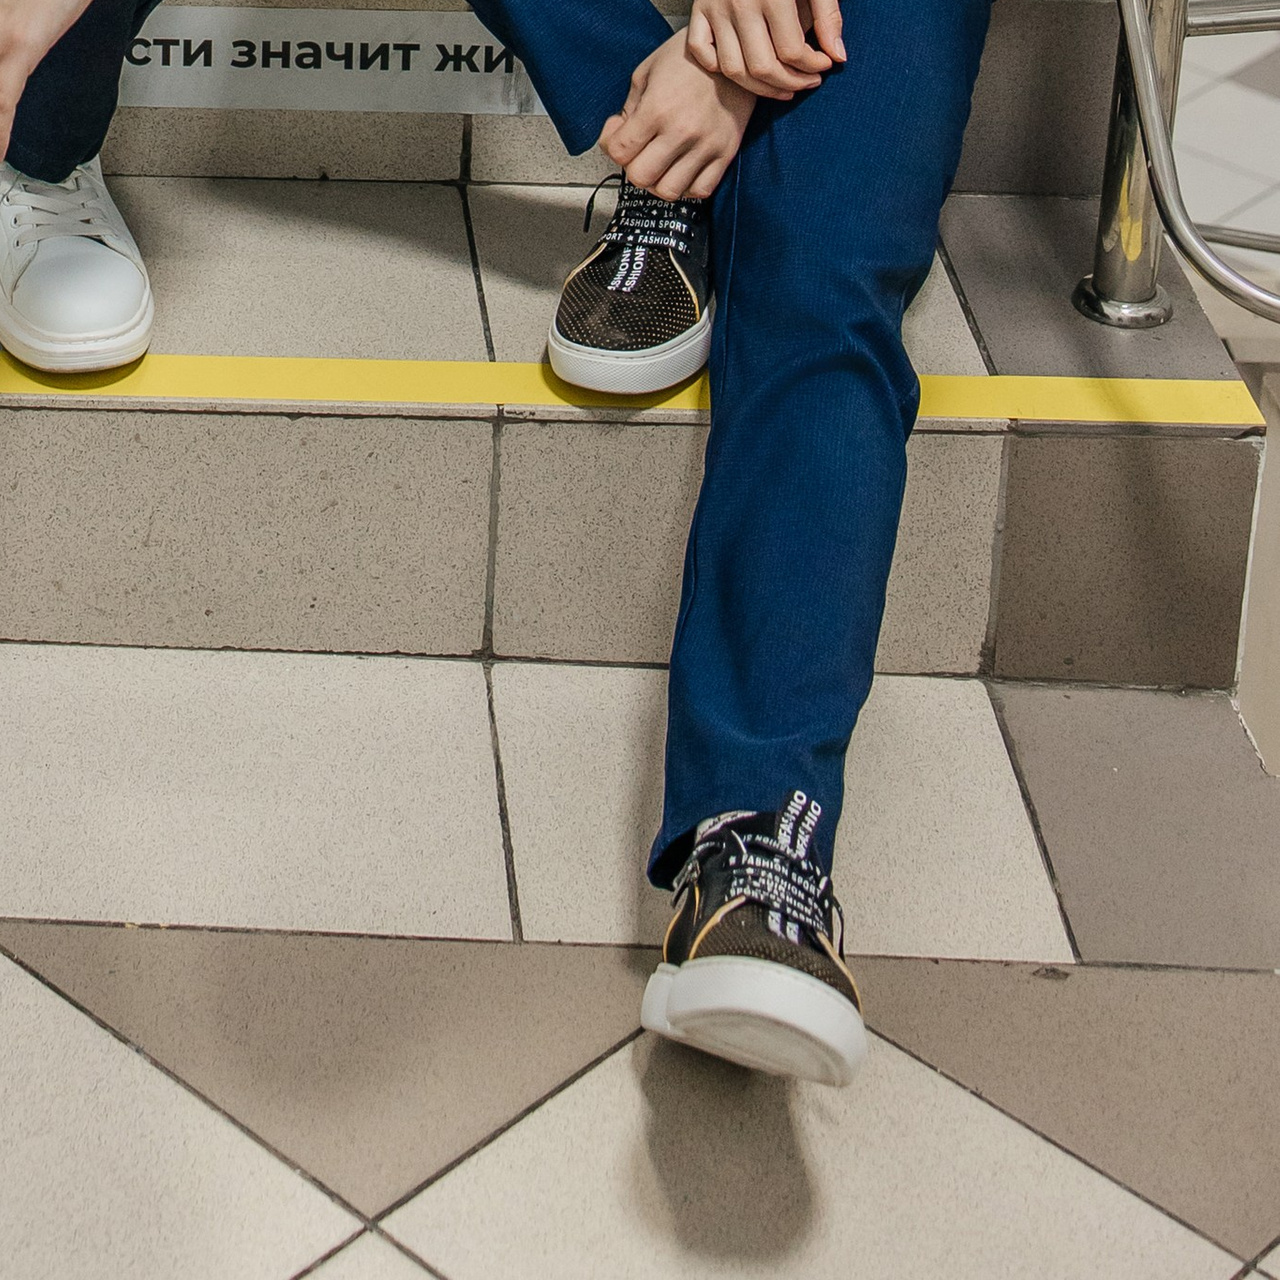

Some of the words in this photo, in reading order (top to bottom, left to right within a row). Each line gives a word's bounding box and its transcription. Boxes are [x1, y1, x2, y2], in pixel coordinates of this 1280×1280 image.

[124, 38, 212, 67] сти
[230, 39, 420, 72] значит
[434, 43, 514, 74] жи
[646, 199, 676, 210] SPORT
[619, 217, 656, 229] FASHION
[658, 220, 688, 234] SPORT
[598, 232, 624, 242] PORT
[637, 234, 677, 248] FASHION
